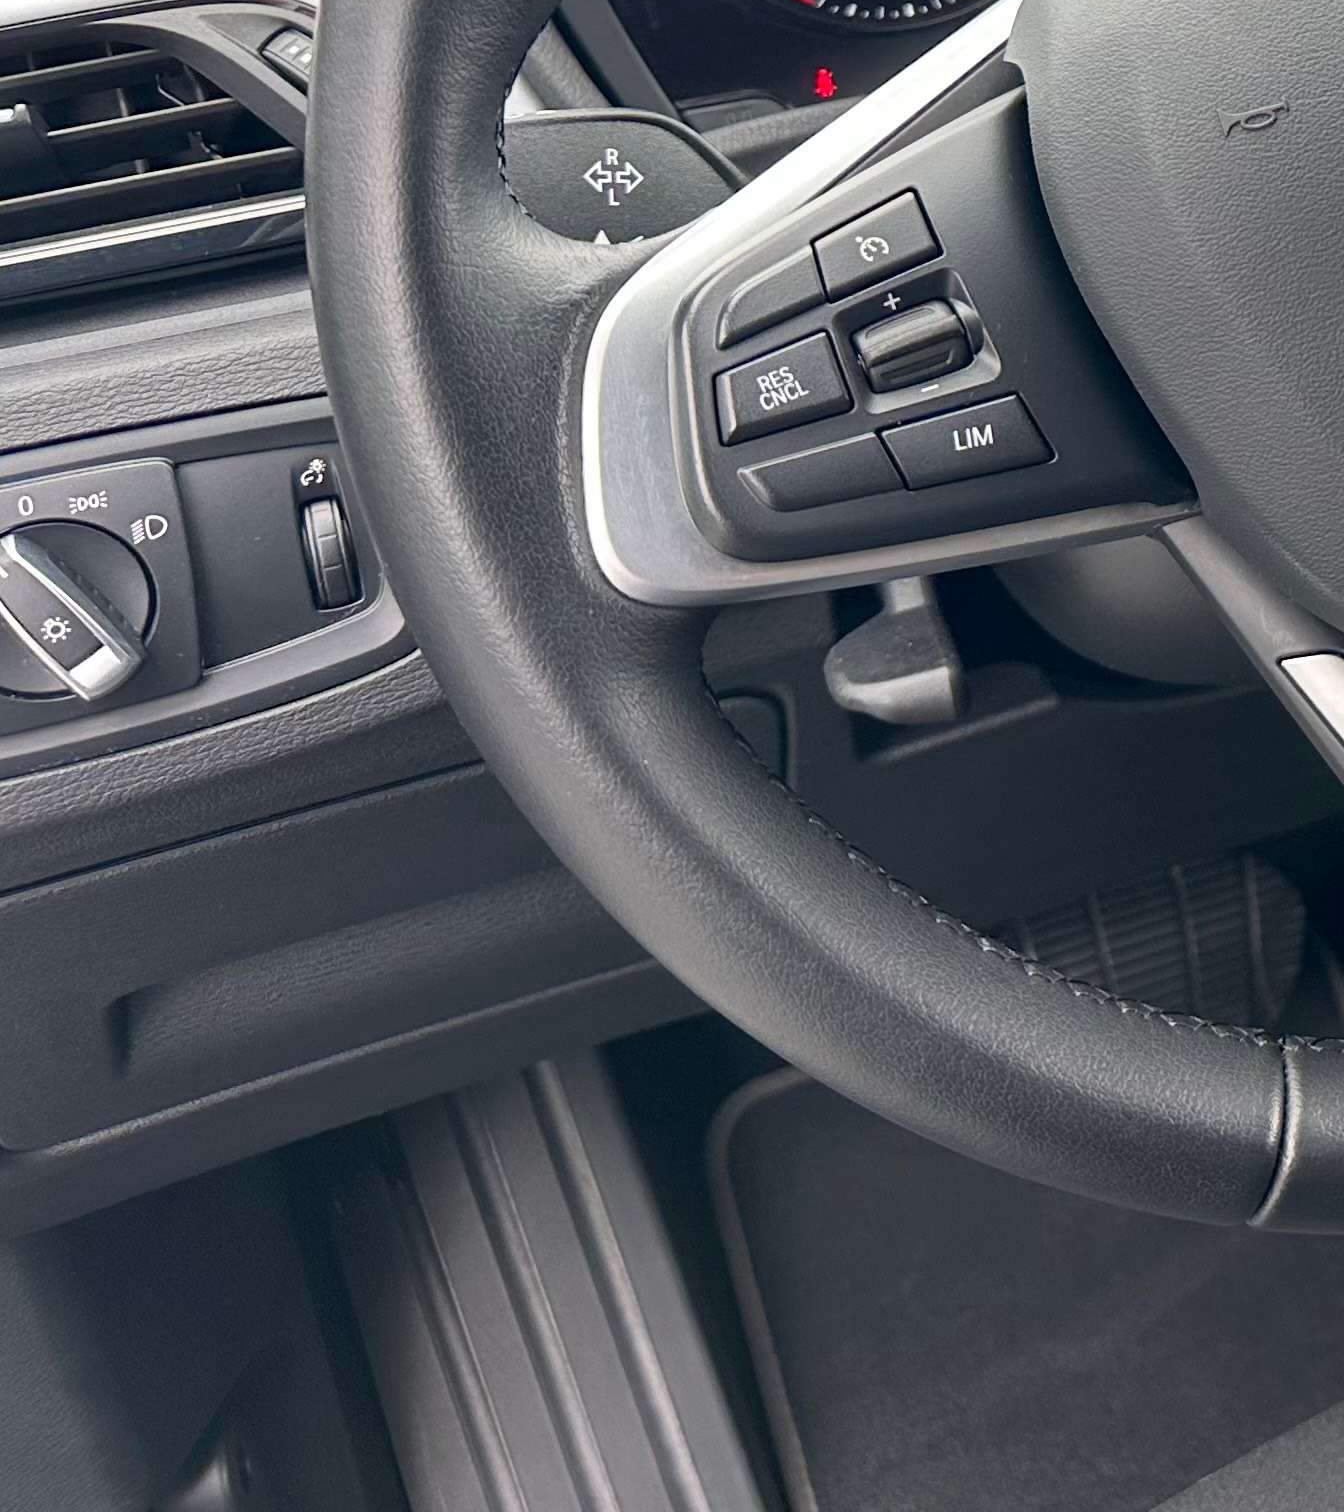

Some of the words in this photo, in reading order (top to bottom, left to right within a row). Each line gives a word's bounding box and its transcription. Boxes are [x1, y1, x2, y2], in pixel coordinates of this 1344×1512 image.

[605, 148, 619, 166] R
[608, 188, 620, 206] L
[756, 366, 794, 393] RES
[759, 380, 809, 411] CNCL
[953, 424, 994, 451] LIM
